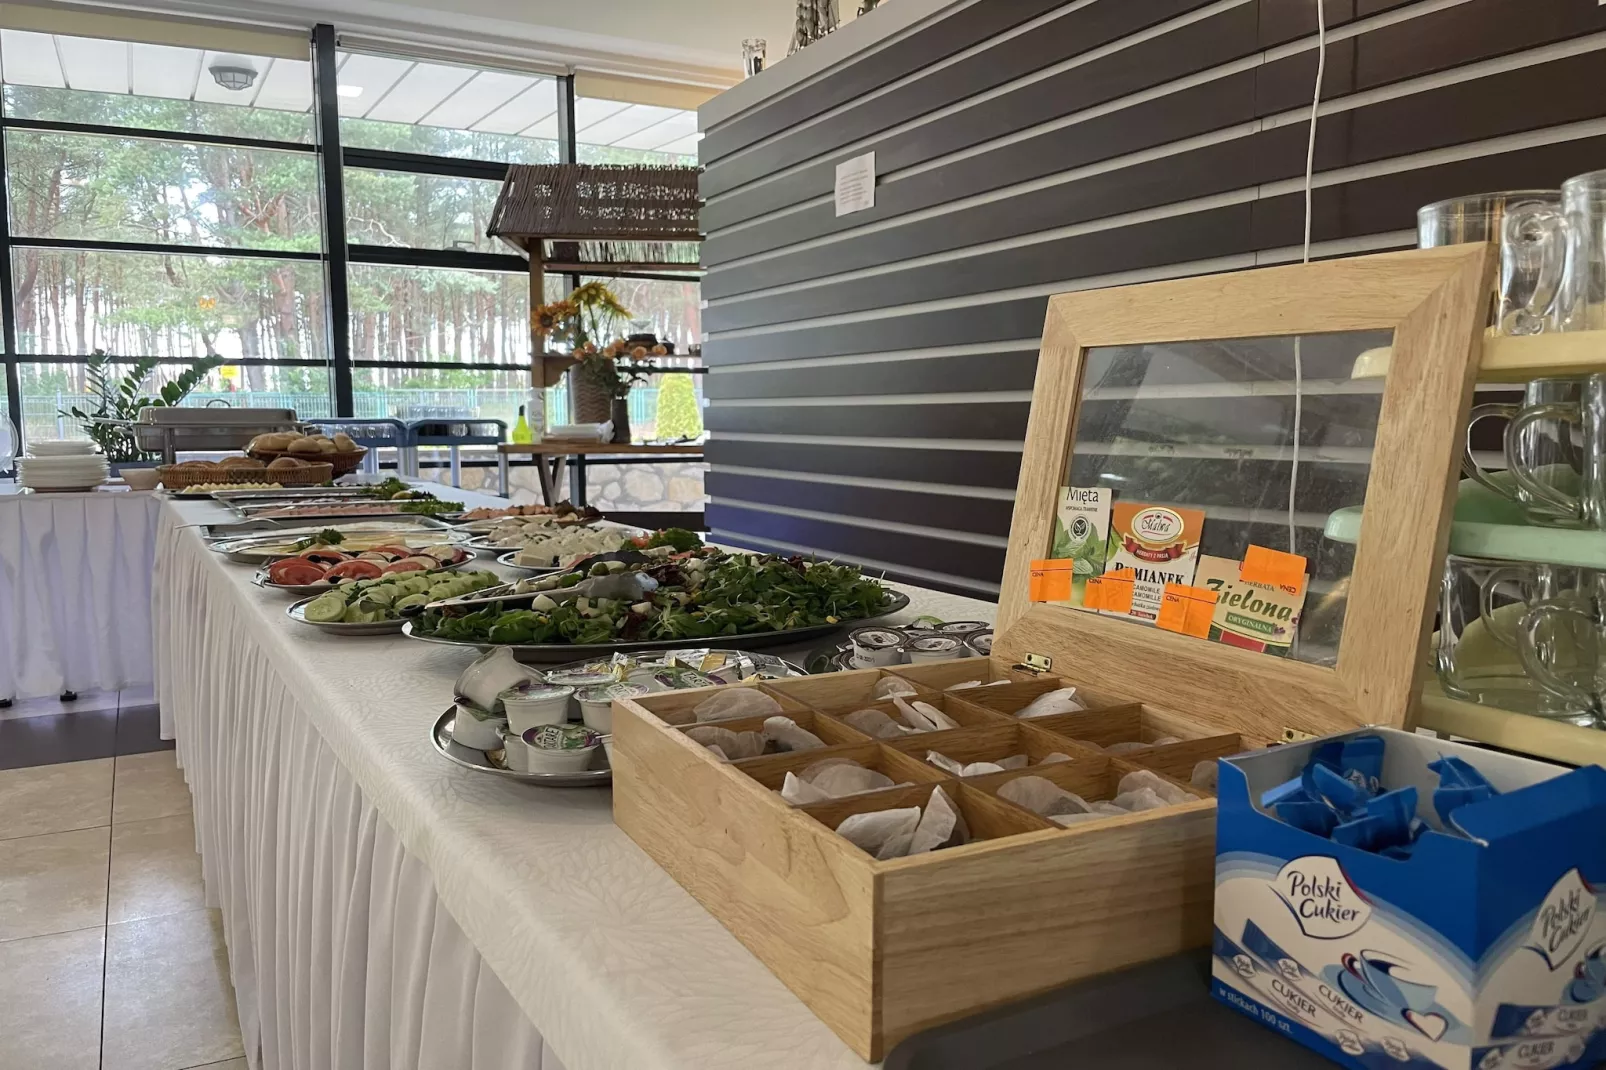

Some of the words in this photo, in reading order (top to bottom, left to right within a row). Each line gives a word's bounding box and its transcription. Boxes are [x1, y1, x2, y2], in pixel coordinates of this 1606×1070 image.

[1115, 562, 1184, 586] RMIANEK
[1228, 614, 1273, 633] ORYGINALNA
[1287, 870, 1342, 902] Polski
[1299, 898, 1361, 923] Cukier
[1272, 979, 1316, 1017] CUKIER
[1319, 984, 1363, 1024] CUKIER
